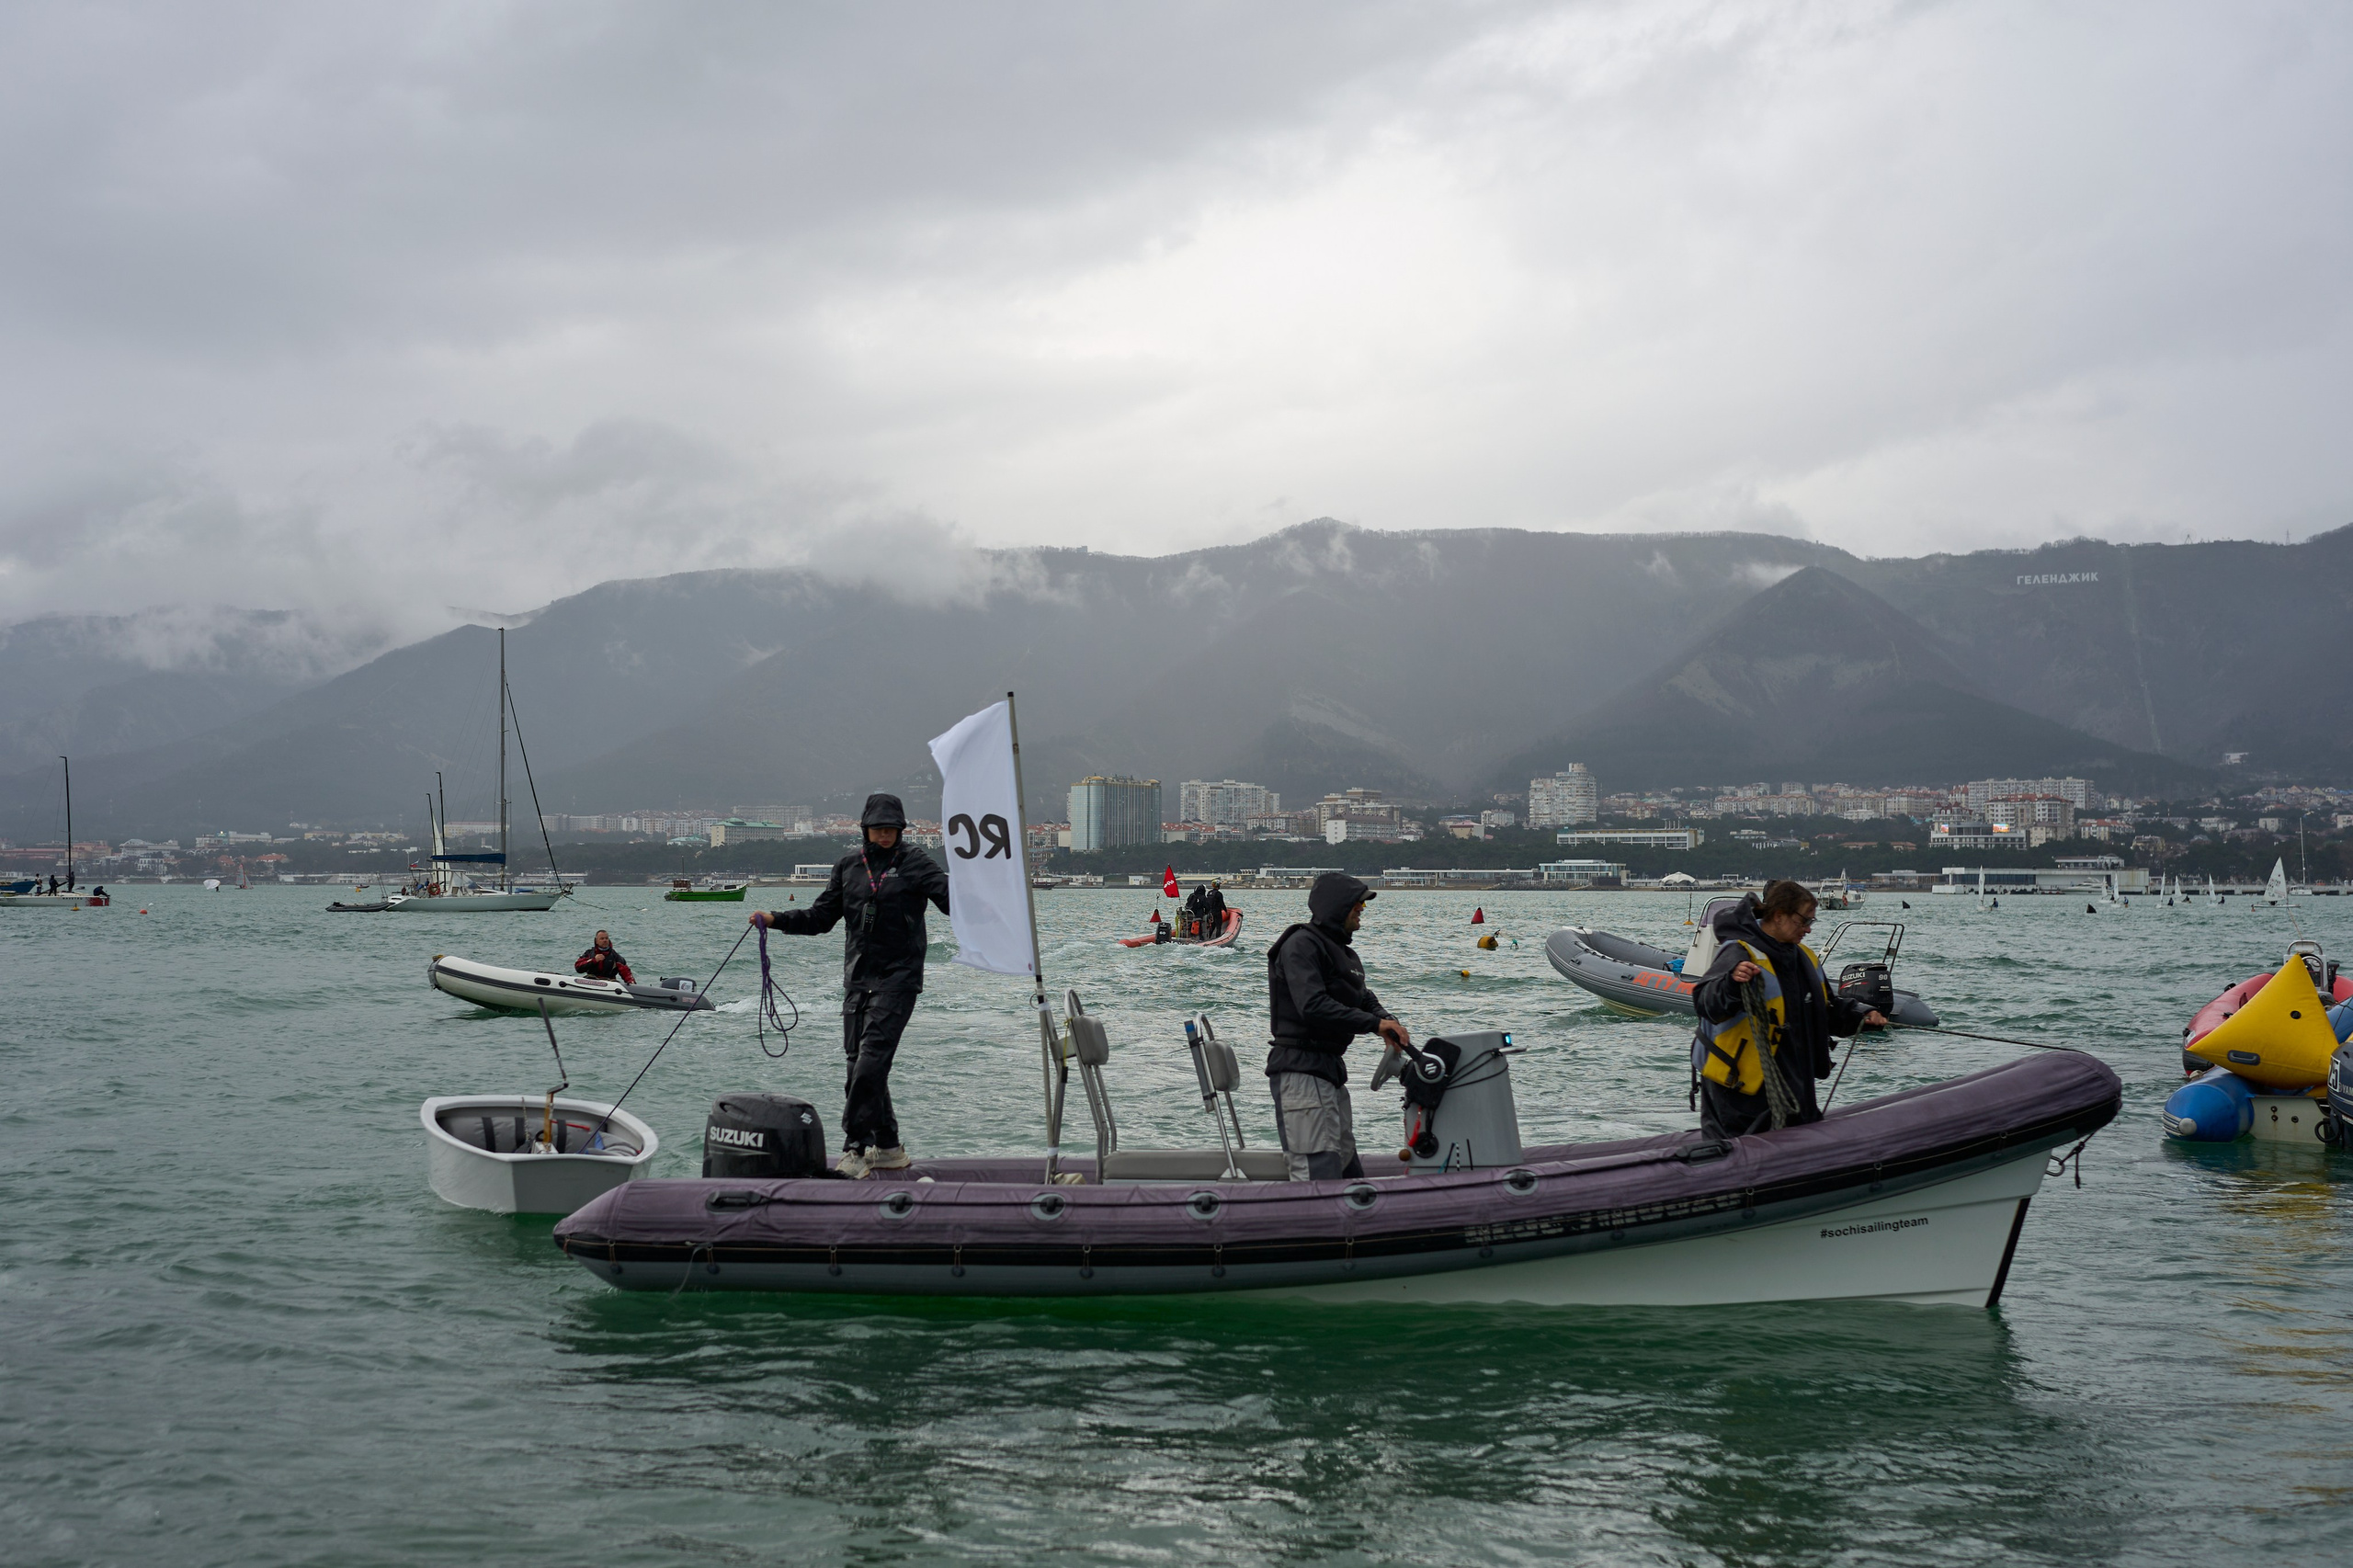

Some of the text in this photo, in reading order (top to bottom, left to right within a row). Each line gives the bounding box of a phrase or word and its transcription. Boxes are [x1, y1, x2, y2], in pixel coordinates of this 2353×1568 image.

[2017, 572, 2099, 585] ГЕЛЕНДЖИК
[1631, 971, 1679, 992] ДГТУ
[1841, 971, 1866, 982] SUZUKI
[710, 1126, 764, 1148] SUZUKI
[1820, 1217, 1928, 1239] #sochisailingteam
